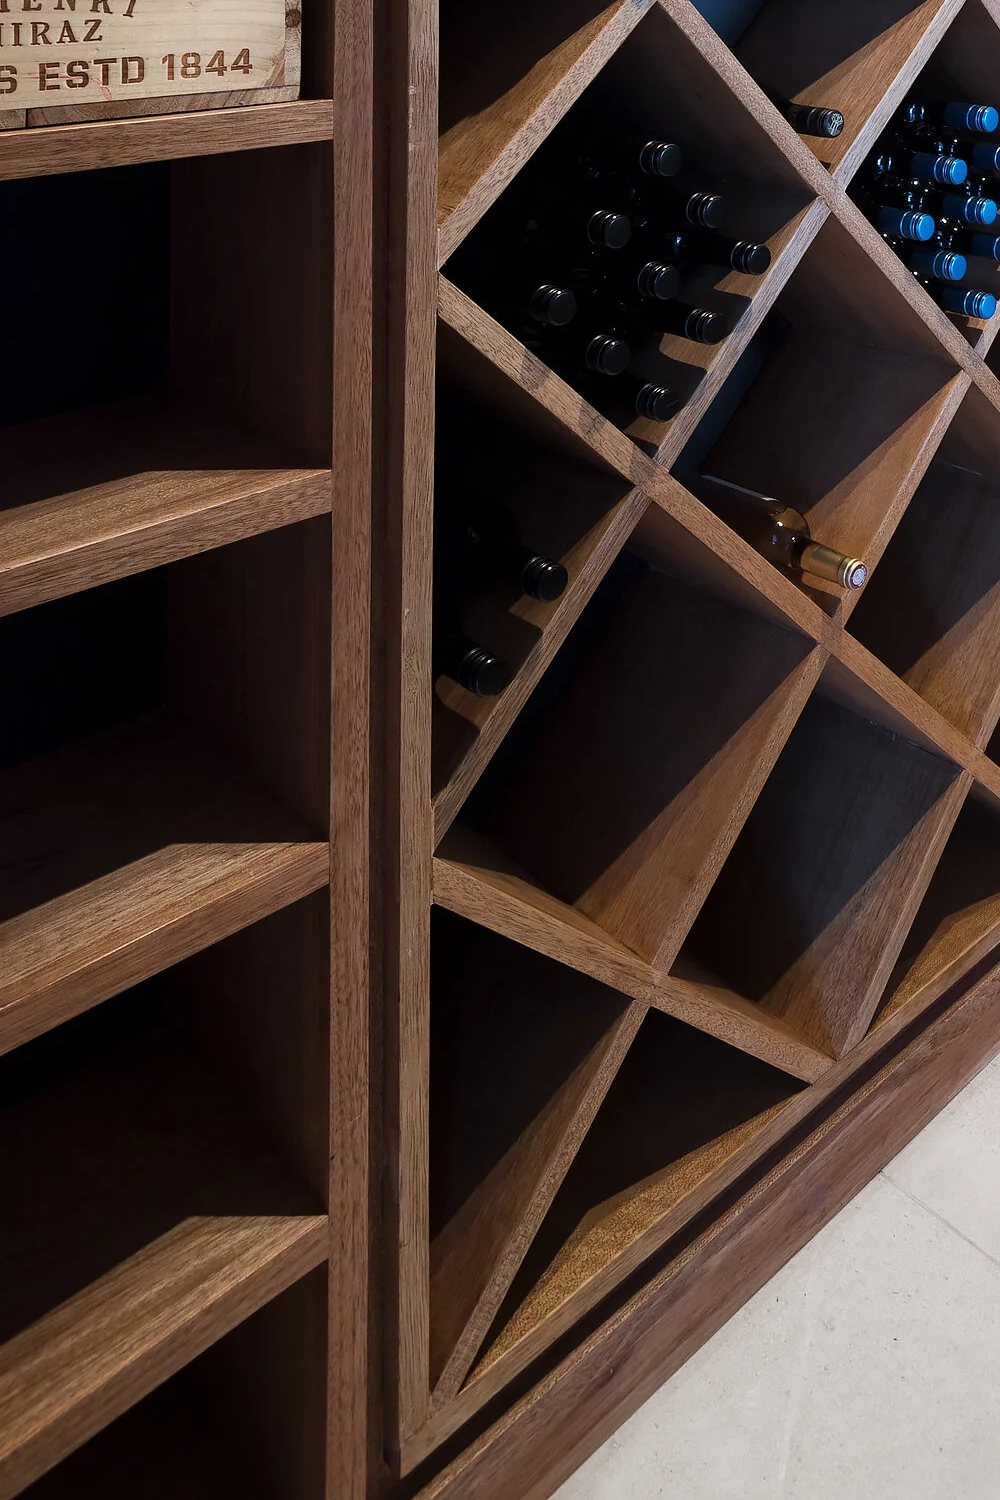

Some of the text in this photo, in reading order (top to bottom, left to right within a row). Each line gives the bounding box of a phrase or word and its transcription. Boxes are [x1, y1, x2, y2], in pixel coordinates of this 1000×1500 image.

[0, 19, 103, 47] IRAZ
[39, 56, 145, 91] ESTD
[161, 48, 253, 81] 1844
